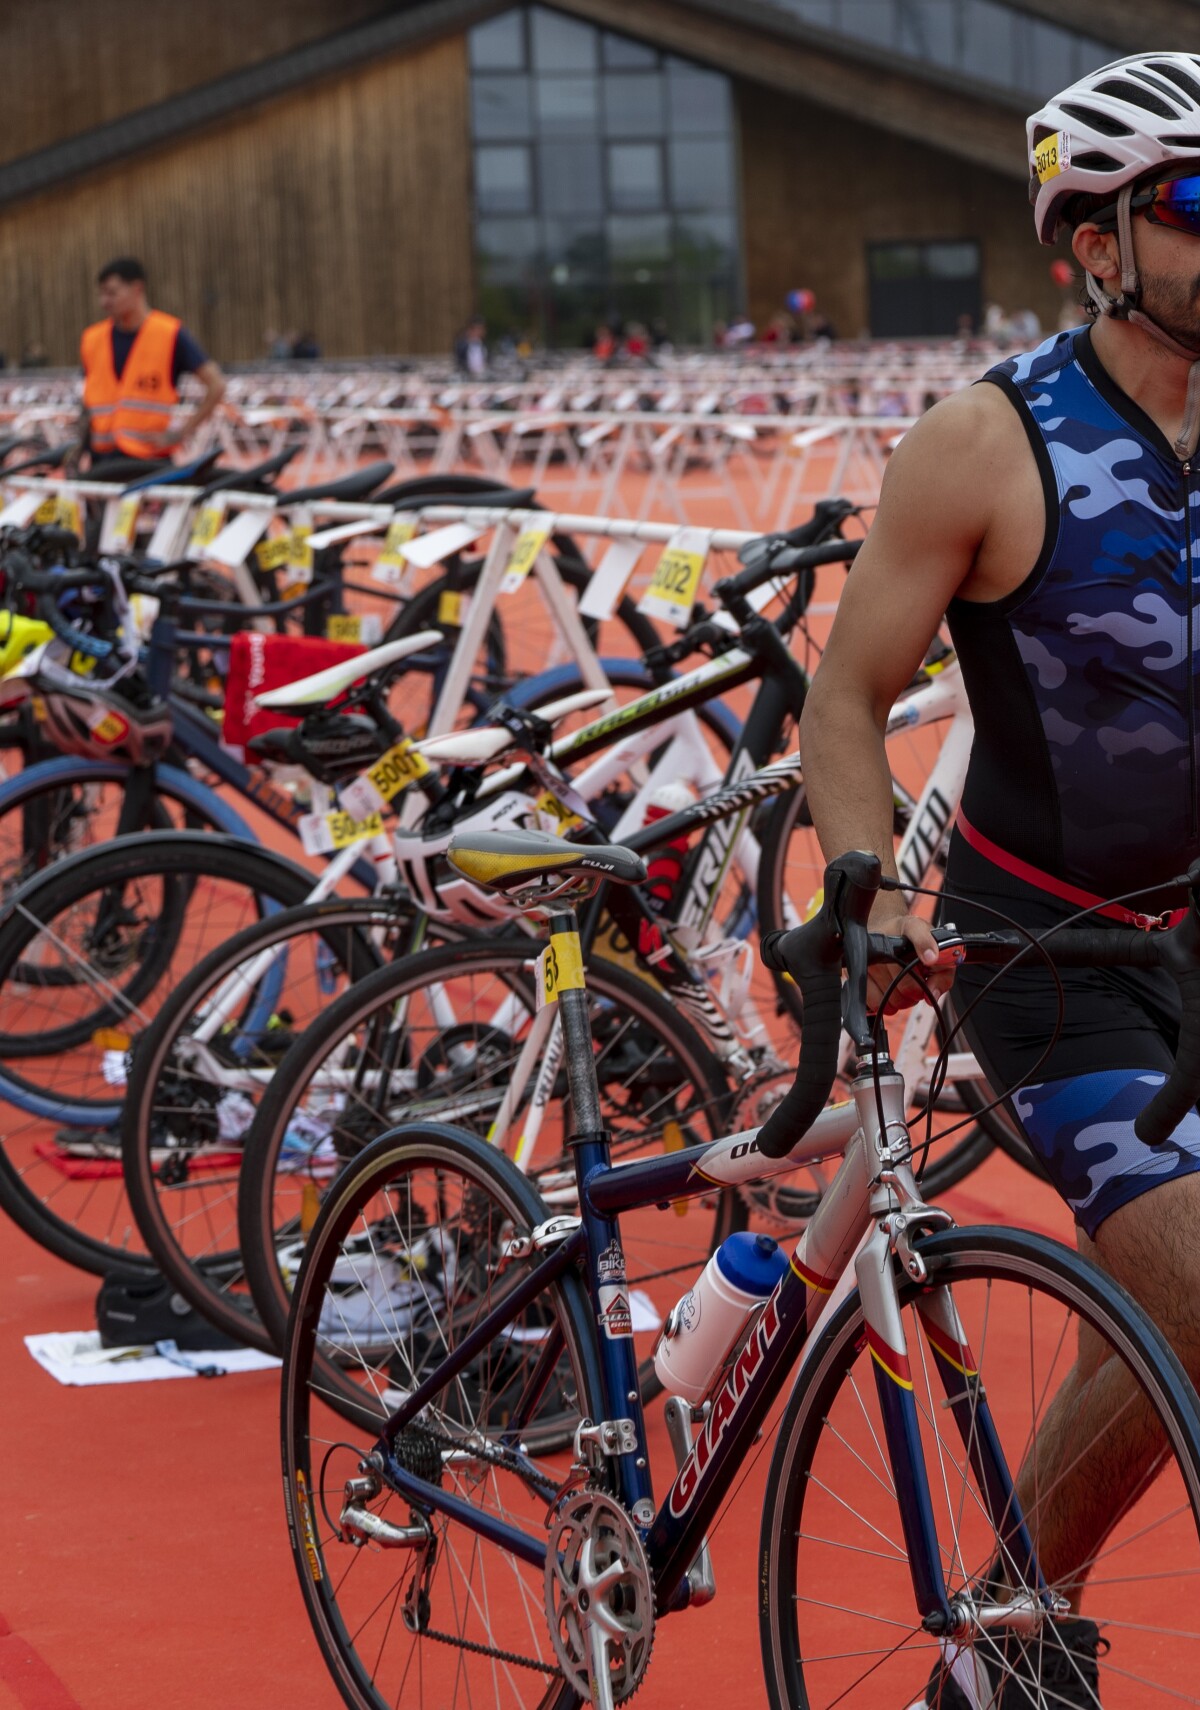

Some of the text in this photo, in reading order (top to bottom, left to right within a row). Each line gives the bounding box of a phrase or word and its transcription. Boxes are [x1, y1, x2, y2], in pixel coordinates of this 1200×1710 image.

[1036, 147, 1057, 173] 5013
[374, 748, 420, 794] 5001
[581, 859, 615, 871] FUJI
[600, 1259, 626, 1271] BIKE
[669, 1275, 786, 1519] GIANT
